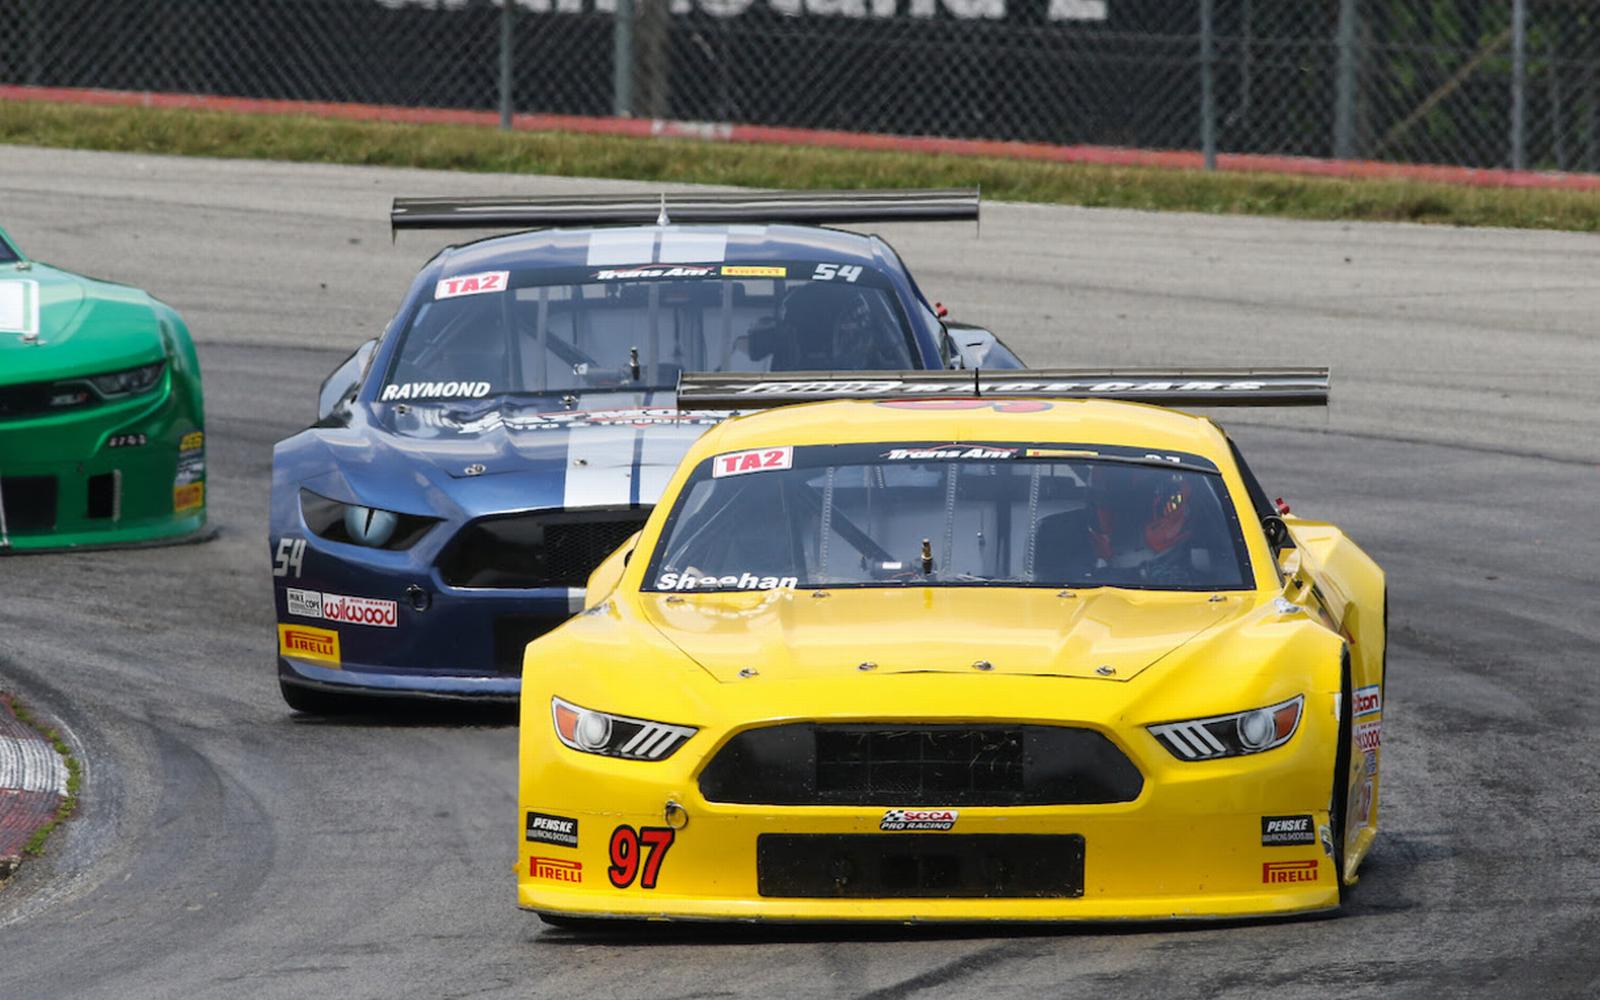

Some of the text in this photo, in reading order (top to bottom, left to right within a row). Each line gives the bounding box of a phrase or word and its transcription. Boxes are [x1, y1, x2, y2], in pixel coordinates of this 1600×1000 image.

[597, 267, 708, 280] Trans Am
[812, 263, 863, 282] 54
[445, 275, 500, 293] TA2
[381, 381, 491, 401] RAYMOND
[722, 450, 784, 473] TA2
[888, 448, 1011, 460] Trans Am
[273, 538, 307, 578] 54
[323, 598, 396, 625] wilwood
[285, 630, 334, 656] PIRELLI
[533, 817, 574, 833] PENSKE
[904, 812, 953, 820] SCCA
[881, 822, 952, 830] PRO RACING
[1267, 819, 1308, 833] PENSKE
[608, 824, 675, 888] 97
[530, 856, 582, 883] PIRELLI
[1262, 859, 1318, 883] PIRELLI
